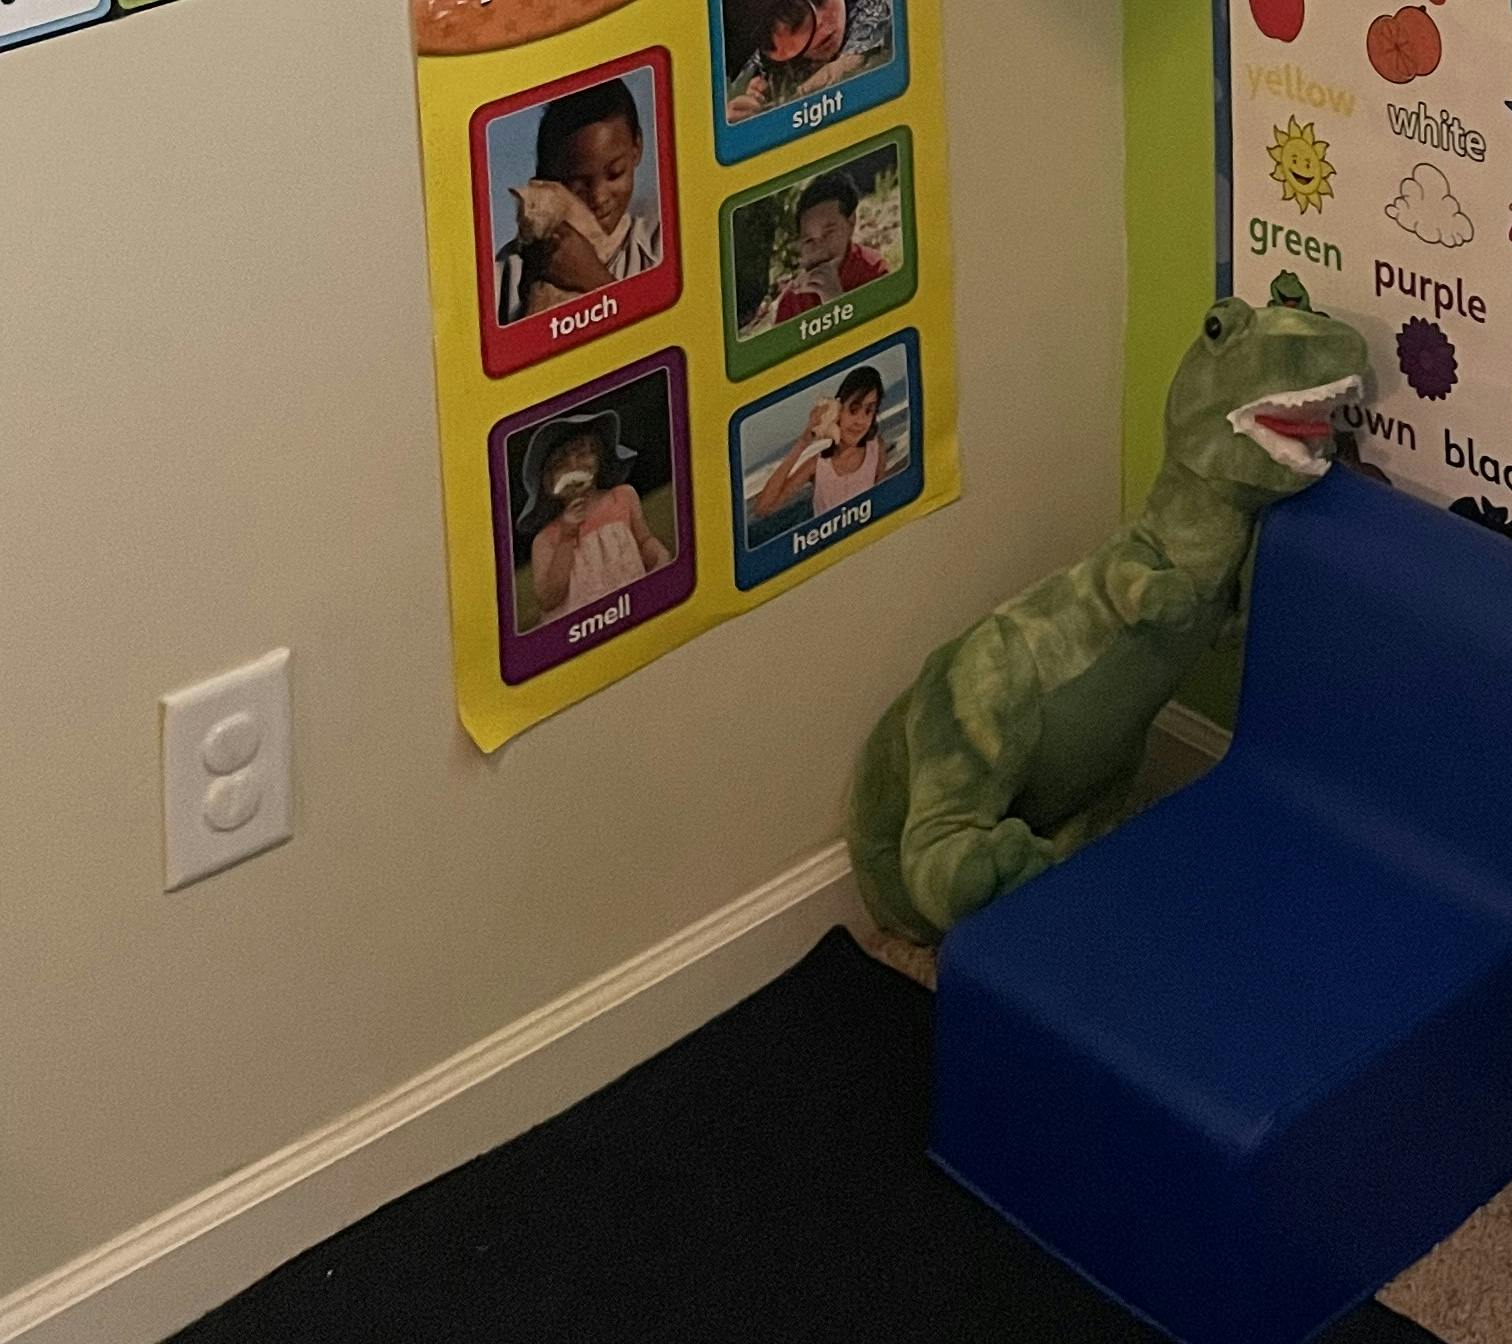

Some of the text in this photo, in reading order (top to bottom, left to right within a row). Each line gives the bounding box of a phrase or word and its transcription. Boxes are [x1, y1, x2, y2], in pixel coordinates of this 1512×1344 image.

[792, 91, 844, 128] sight
[1246, 63, 1355, 117] yellow
[1387, 102, 1487, 162] white
[1249, 217, 1343, 271] green
[549, 295, 618, 339] touch
[1375, 259, 1487, 323] purple
[800, 301, 854, 340] taste
[1340, 403, 1416, 450] own
[793, 499, 872, 554] hearing
[568, 593, 631, 643] smell
